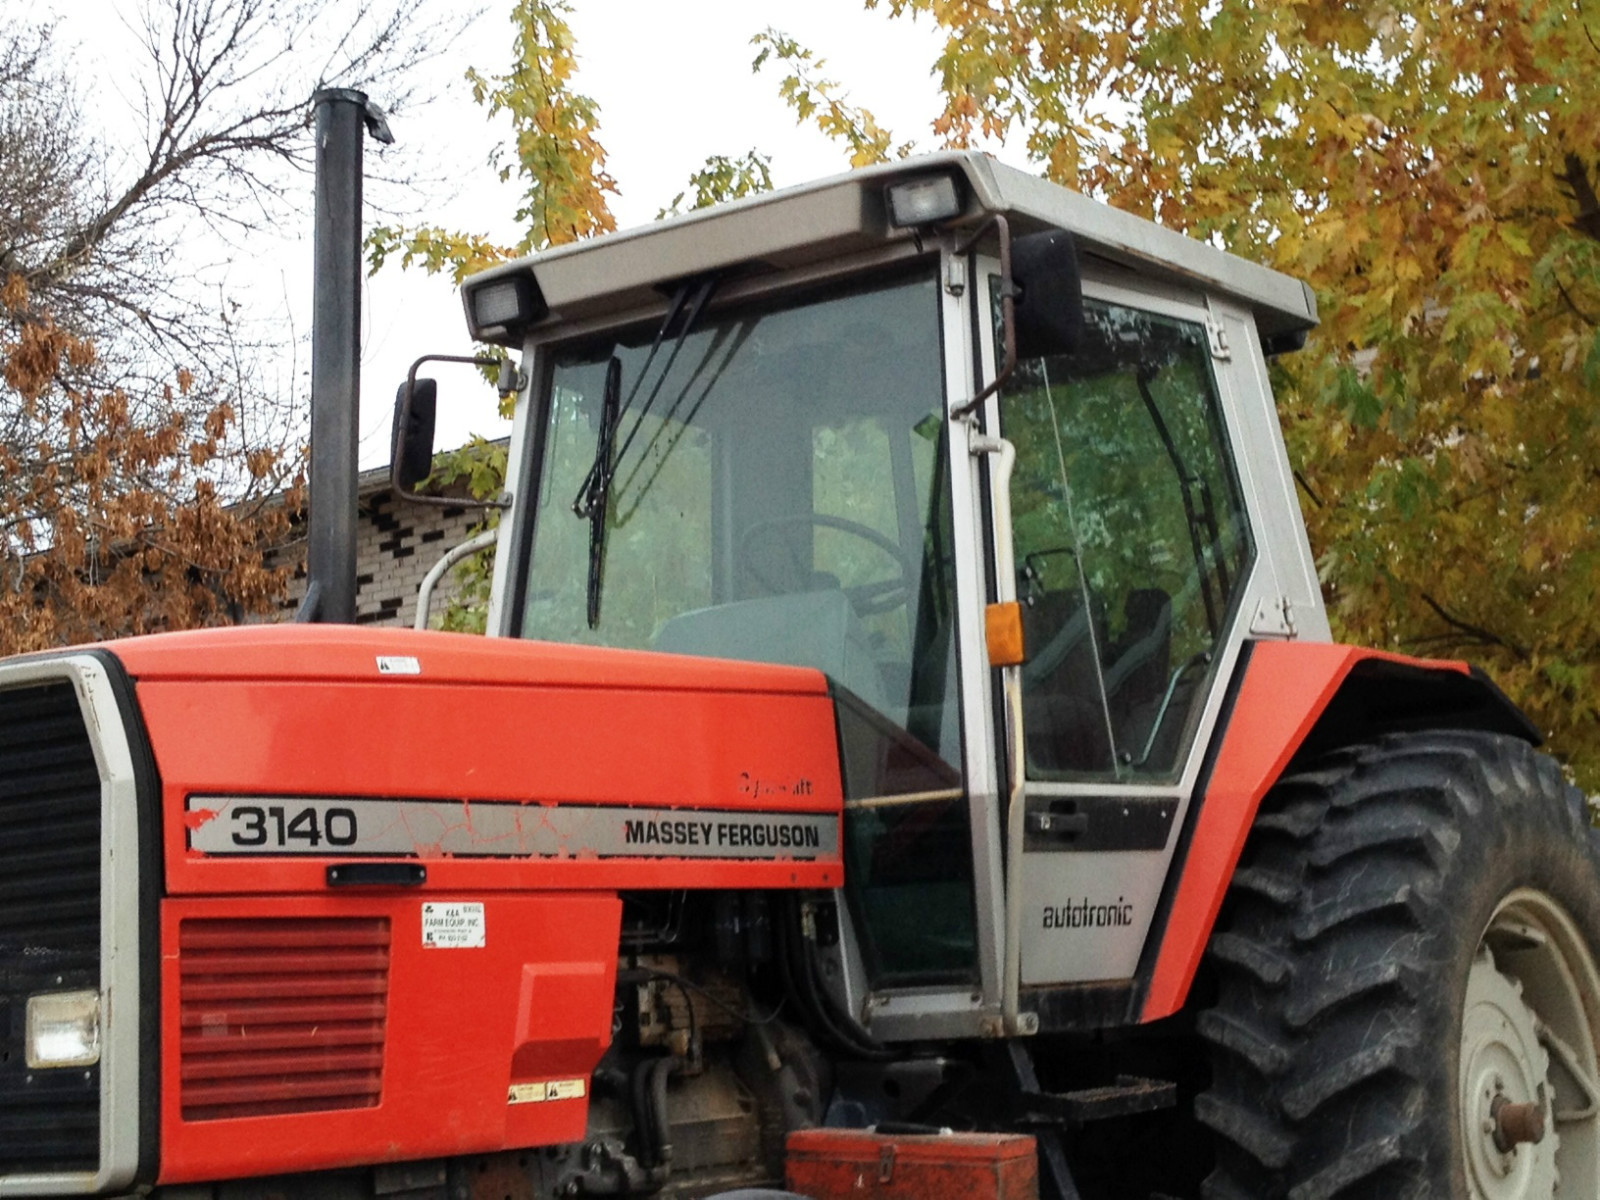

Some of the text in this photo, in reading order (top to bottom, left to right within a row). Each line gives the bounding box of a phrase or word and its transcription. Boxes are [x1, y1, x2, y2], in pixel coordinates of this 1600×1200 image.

[231, 806, 358, 847] 3140
[625, 820, 820, 847] MASSEY FERGUSON
[1043, 896, 1133, 929] autotronic
